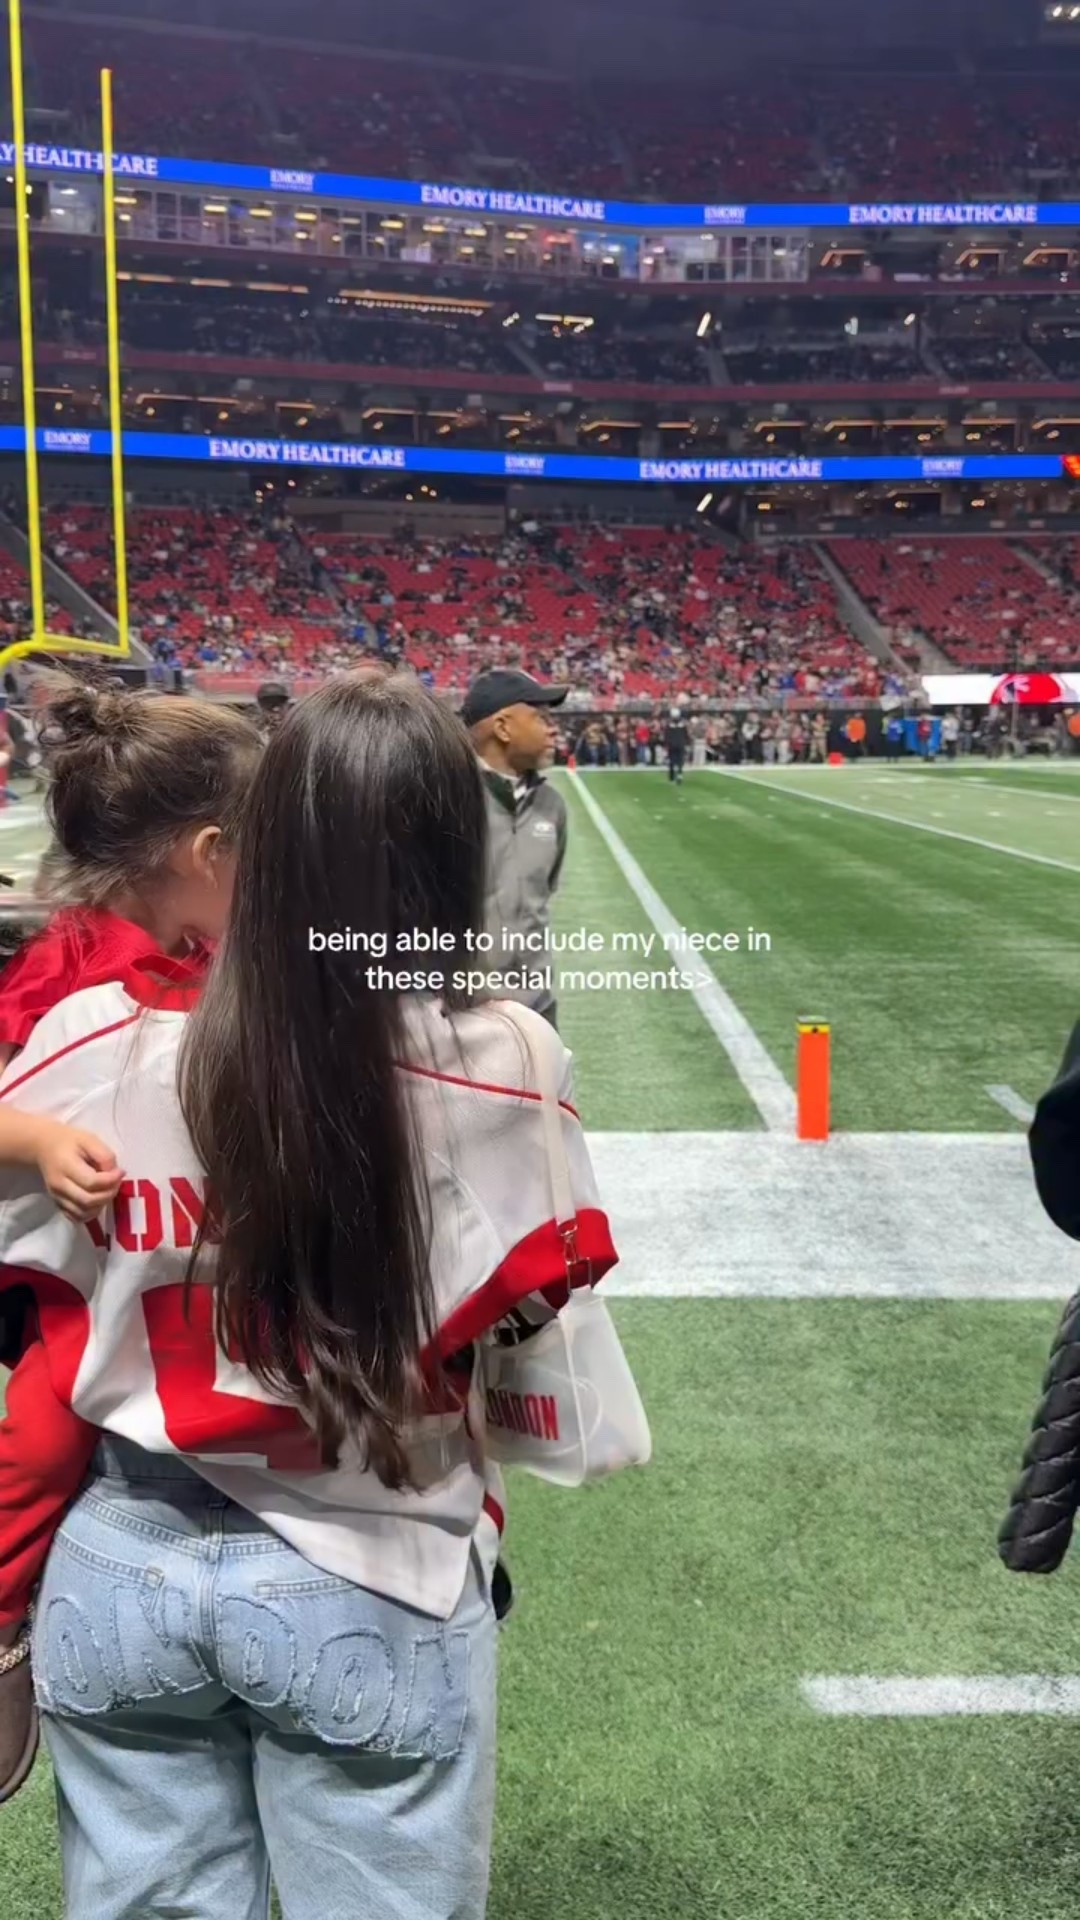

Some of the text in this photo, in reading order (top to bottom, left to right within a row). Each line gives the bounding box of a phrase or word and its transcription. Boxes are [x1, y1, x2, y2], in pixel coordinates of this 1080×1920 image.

[420, 184, 605, 220] EMORY HEALTHCARE
[849, 204, 1037, 223] EMORY HEALTHCARE
[208, 440, 405, 467] EMORY HEALTHCARE
[639, 459, 822, 479] EMORY HEALTHCARE
[486, 1386, 560, 1441] ONDON
[33, 1584, 471, 1758] ONDON
